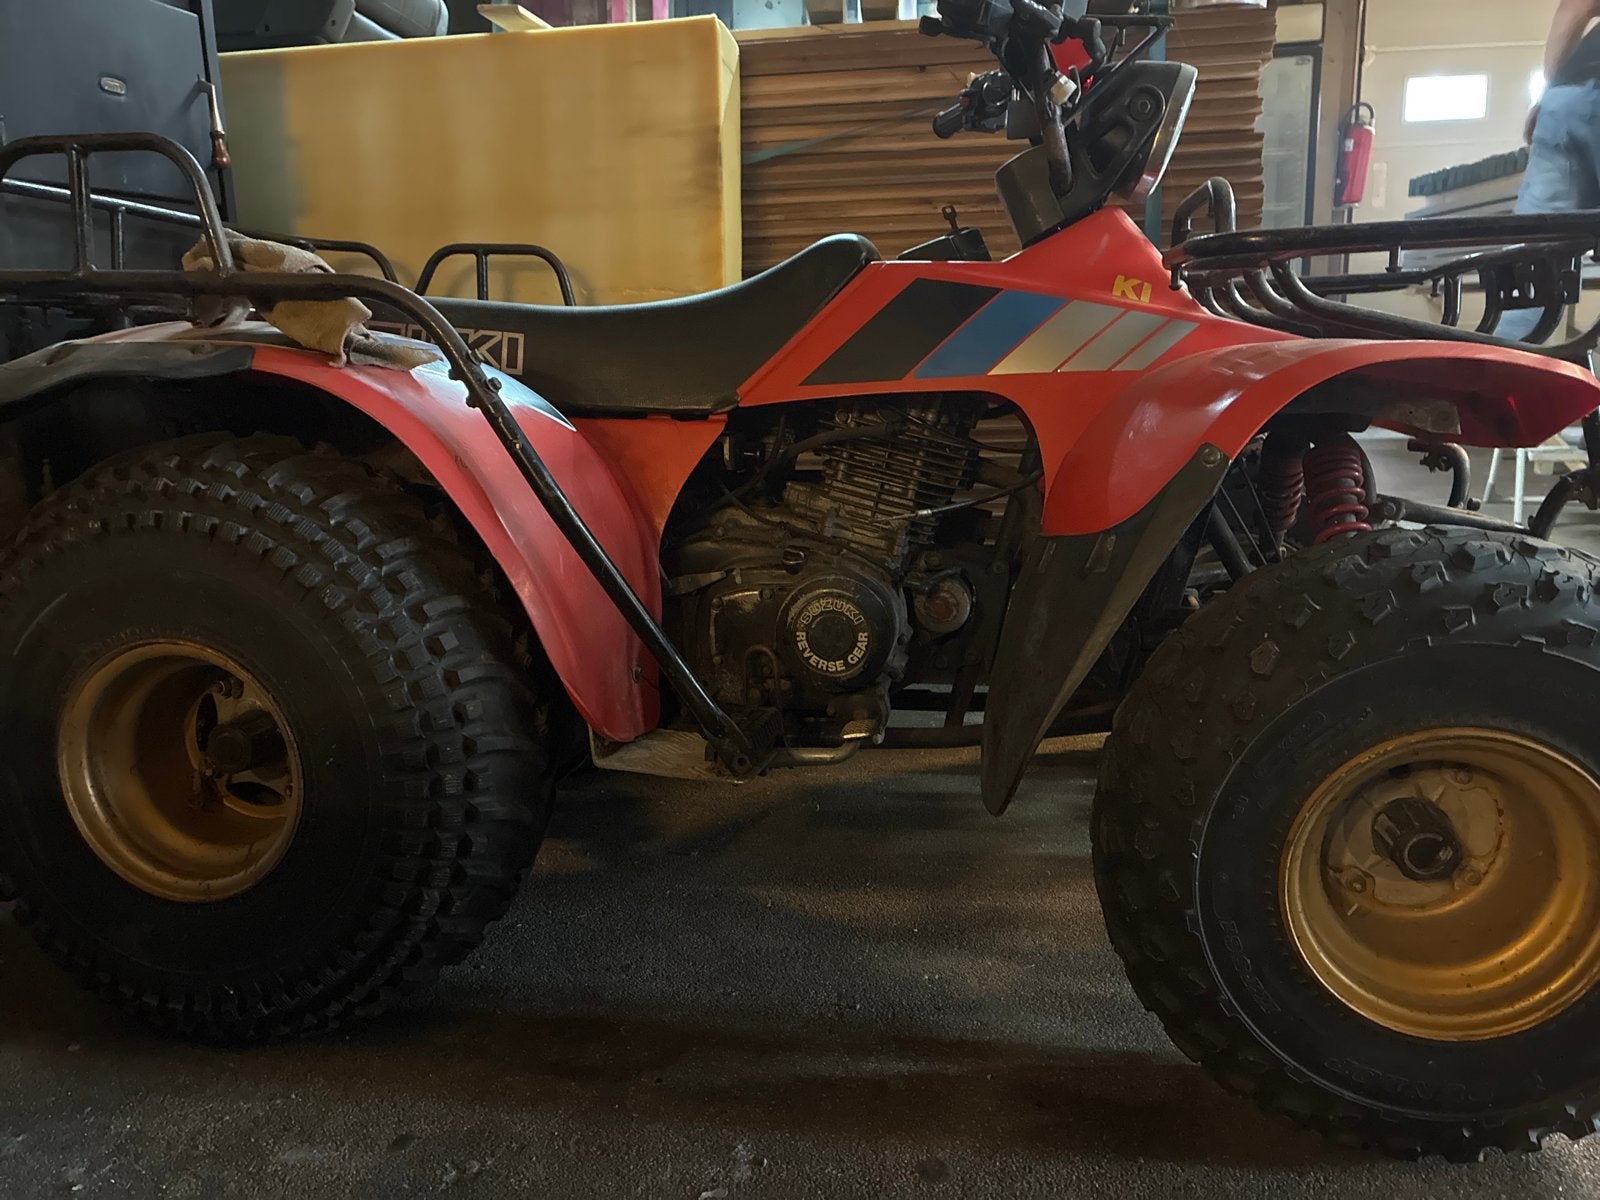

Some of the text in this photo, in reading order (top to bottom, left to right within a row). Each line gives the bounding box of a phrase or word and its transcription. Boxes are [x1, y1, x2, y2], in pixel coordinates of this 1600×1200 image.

[1111, 274, 1153, 305] KI
[800, 598, 865, 626] SUZUKI
[795, 631, 869, 672] REVERSE GEAR
